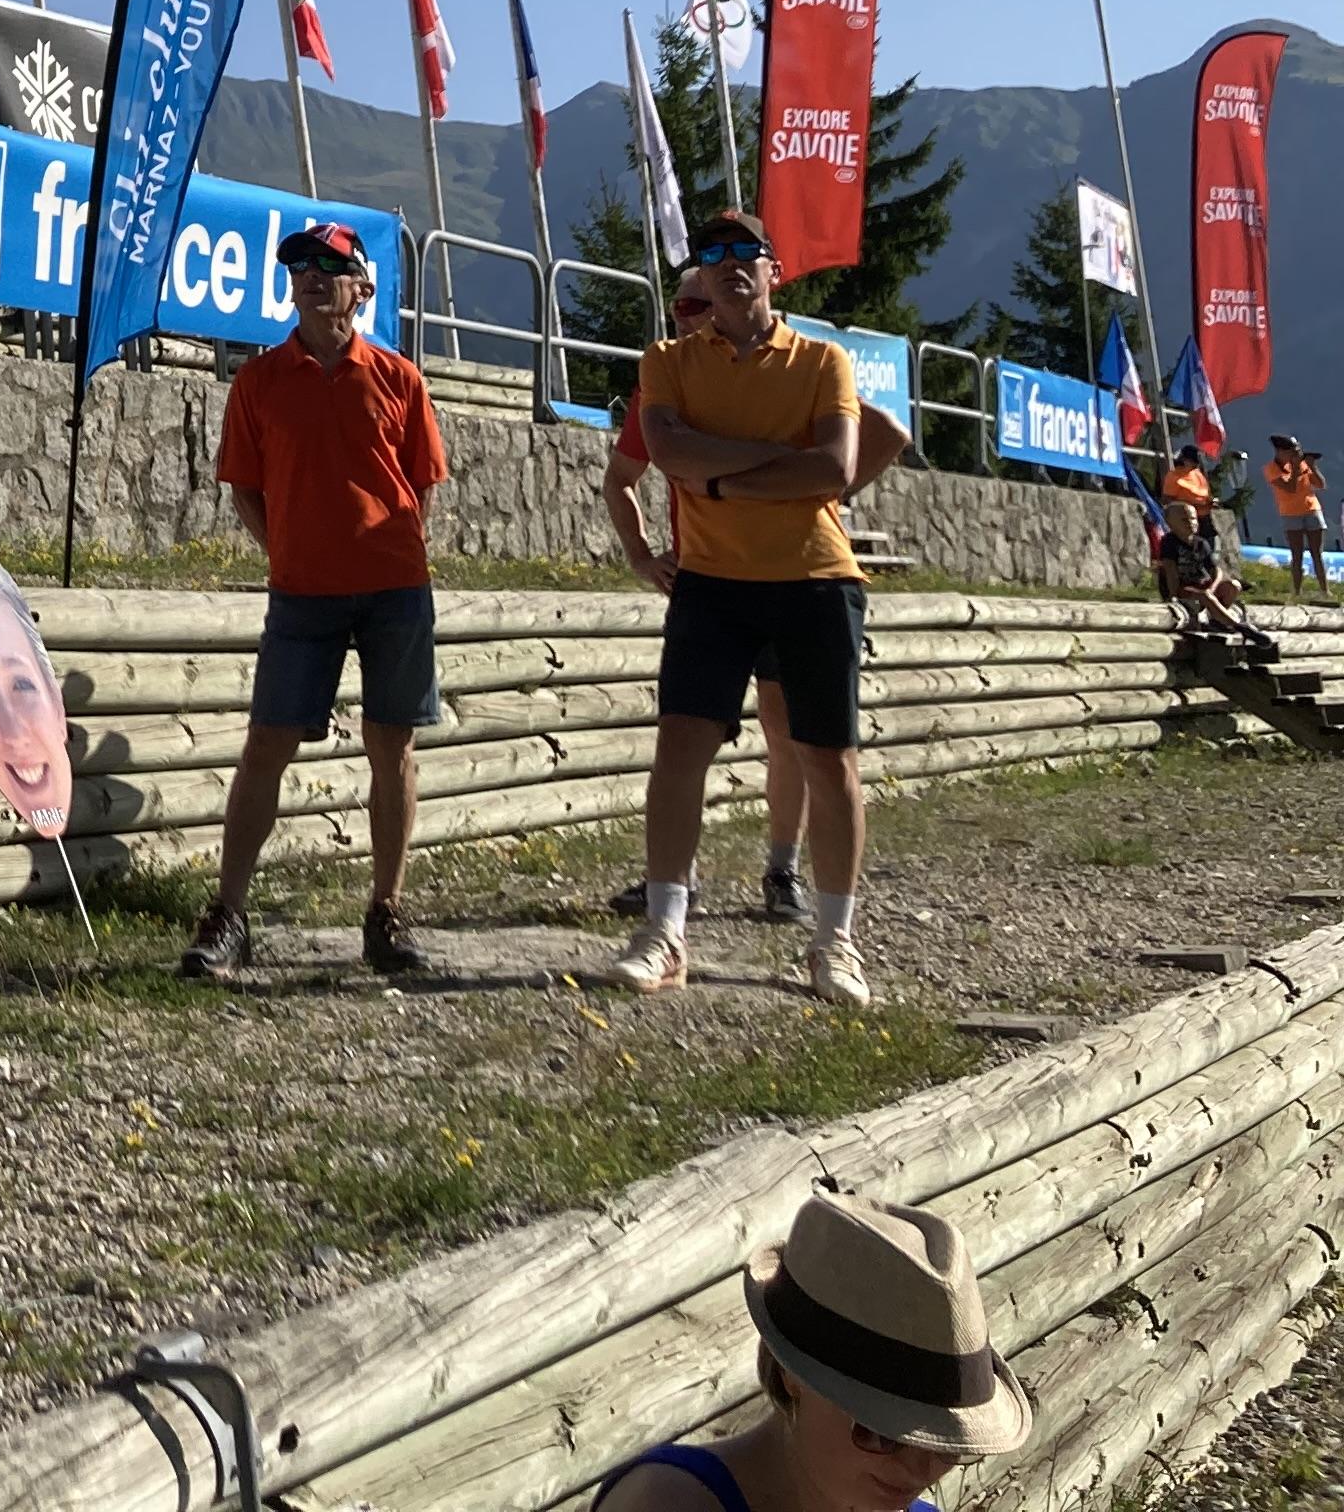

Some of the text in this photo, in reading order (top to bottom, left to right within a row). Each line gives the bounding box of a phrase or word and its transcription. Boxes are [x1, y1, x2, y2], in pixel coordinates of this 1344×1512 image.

[782, 108, 852, 130] EXPLORE
[1204, 99, 1265, 126] SAVOIE
[770, 129, 861, 167] SAVOIE
[32, 161, 247, 314] frce
[1027, 382, 1087, 457] france
